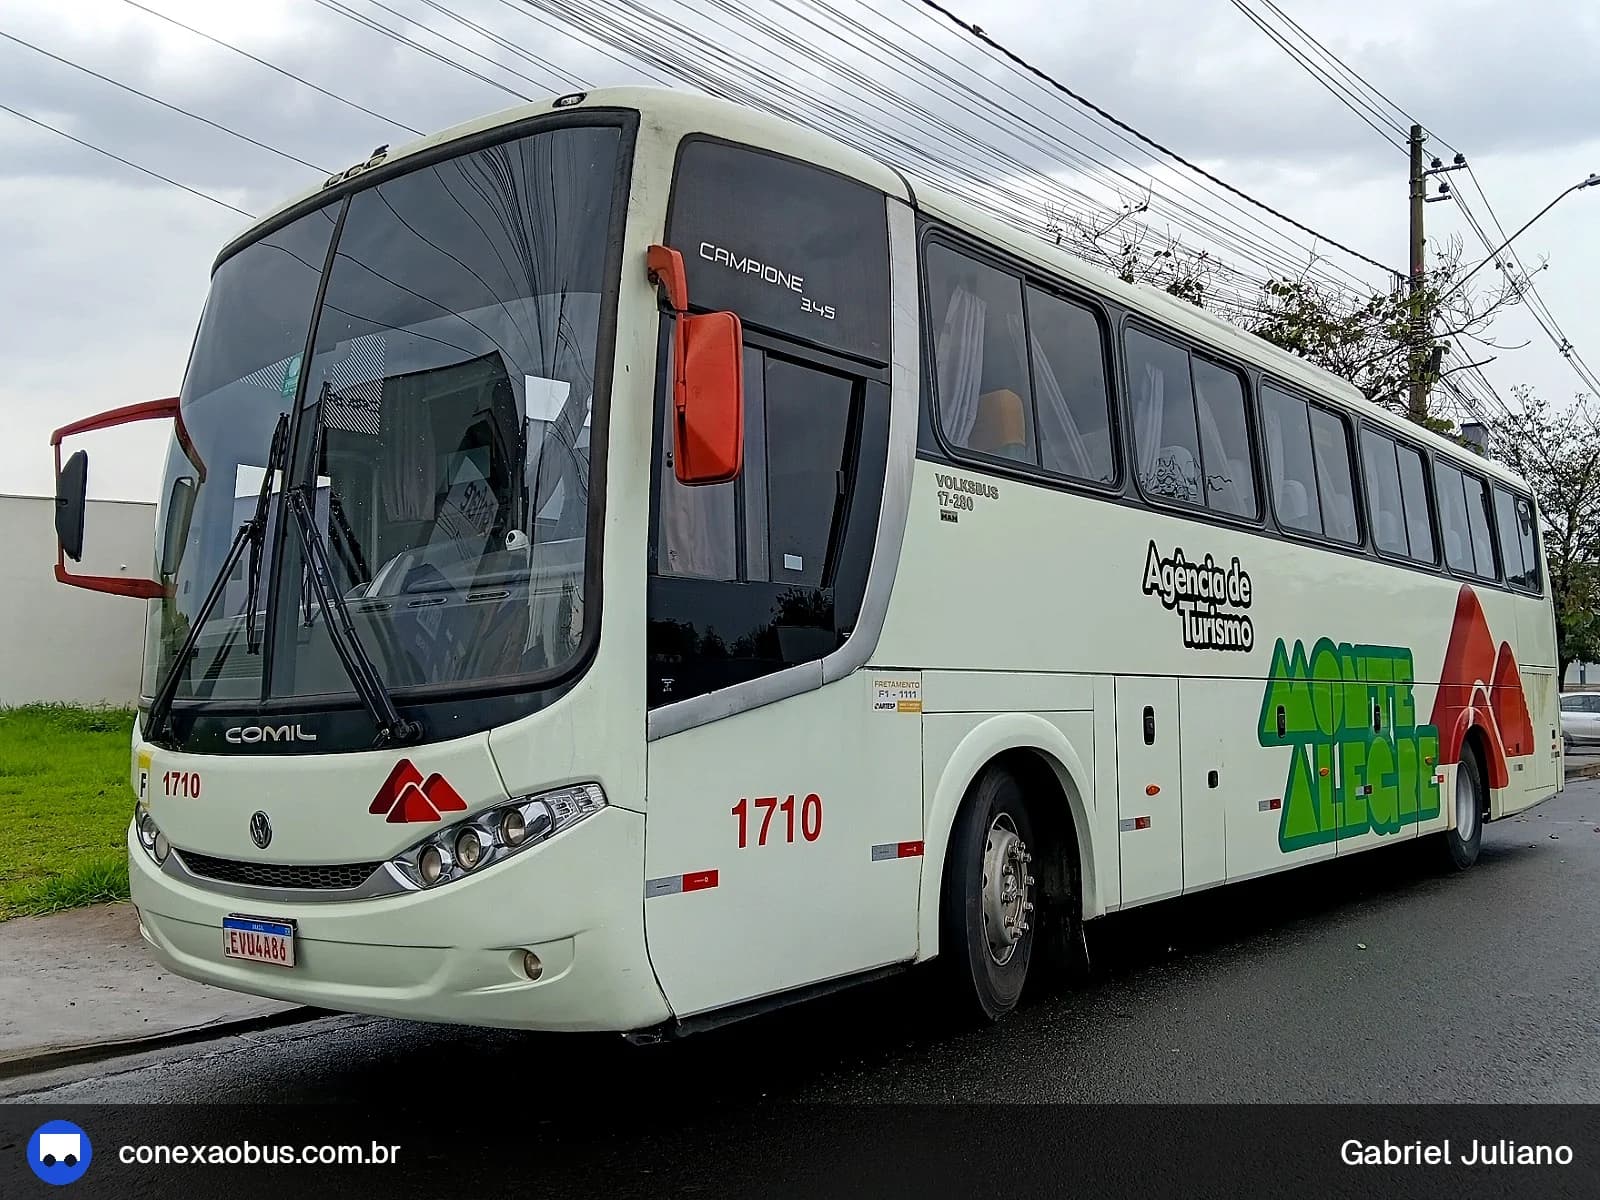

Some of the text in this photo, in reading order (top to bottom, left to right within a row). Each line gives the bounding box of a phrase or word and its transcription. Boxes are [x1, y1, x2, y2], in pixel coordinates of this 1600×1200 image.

[699, 242, 804, 293] CAMPIONE
[800, 297, 836, 320] 3.45
[935, 473, 999, 500] VOLKSBUS
[937, 490, 974, 511] 17-280
[1144, 543, 1251, 607] Agência de
[1178, 601, 1253, 650] Turismo
[874, 681, 920, 689] FRETAMENTO
[878, 690, 889, 698] F1
[899, 690, 917, 699] 1111
[1261, 643, 1413, 740] MONTE
[225, 724, 317, 744] COMIL
[139, 772, 147, 798] F
[162, 771, 201, 799] 1710
[1281, 734, 1439, 845] ALEGRE
[731, 793, 823, 849] 1710
[230, 931, 287, 961] EVU4A86
